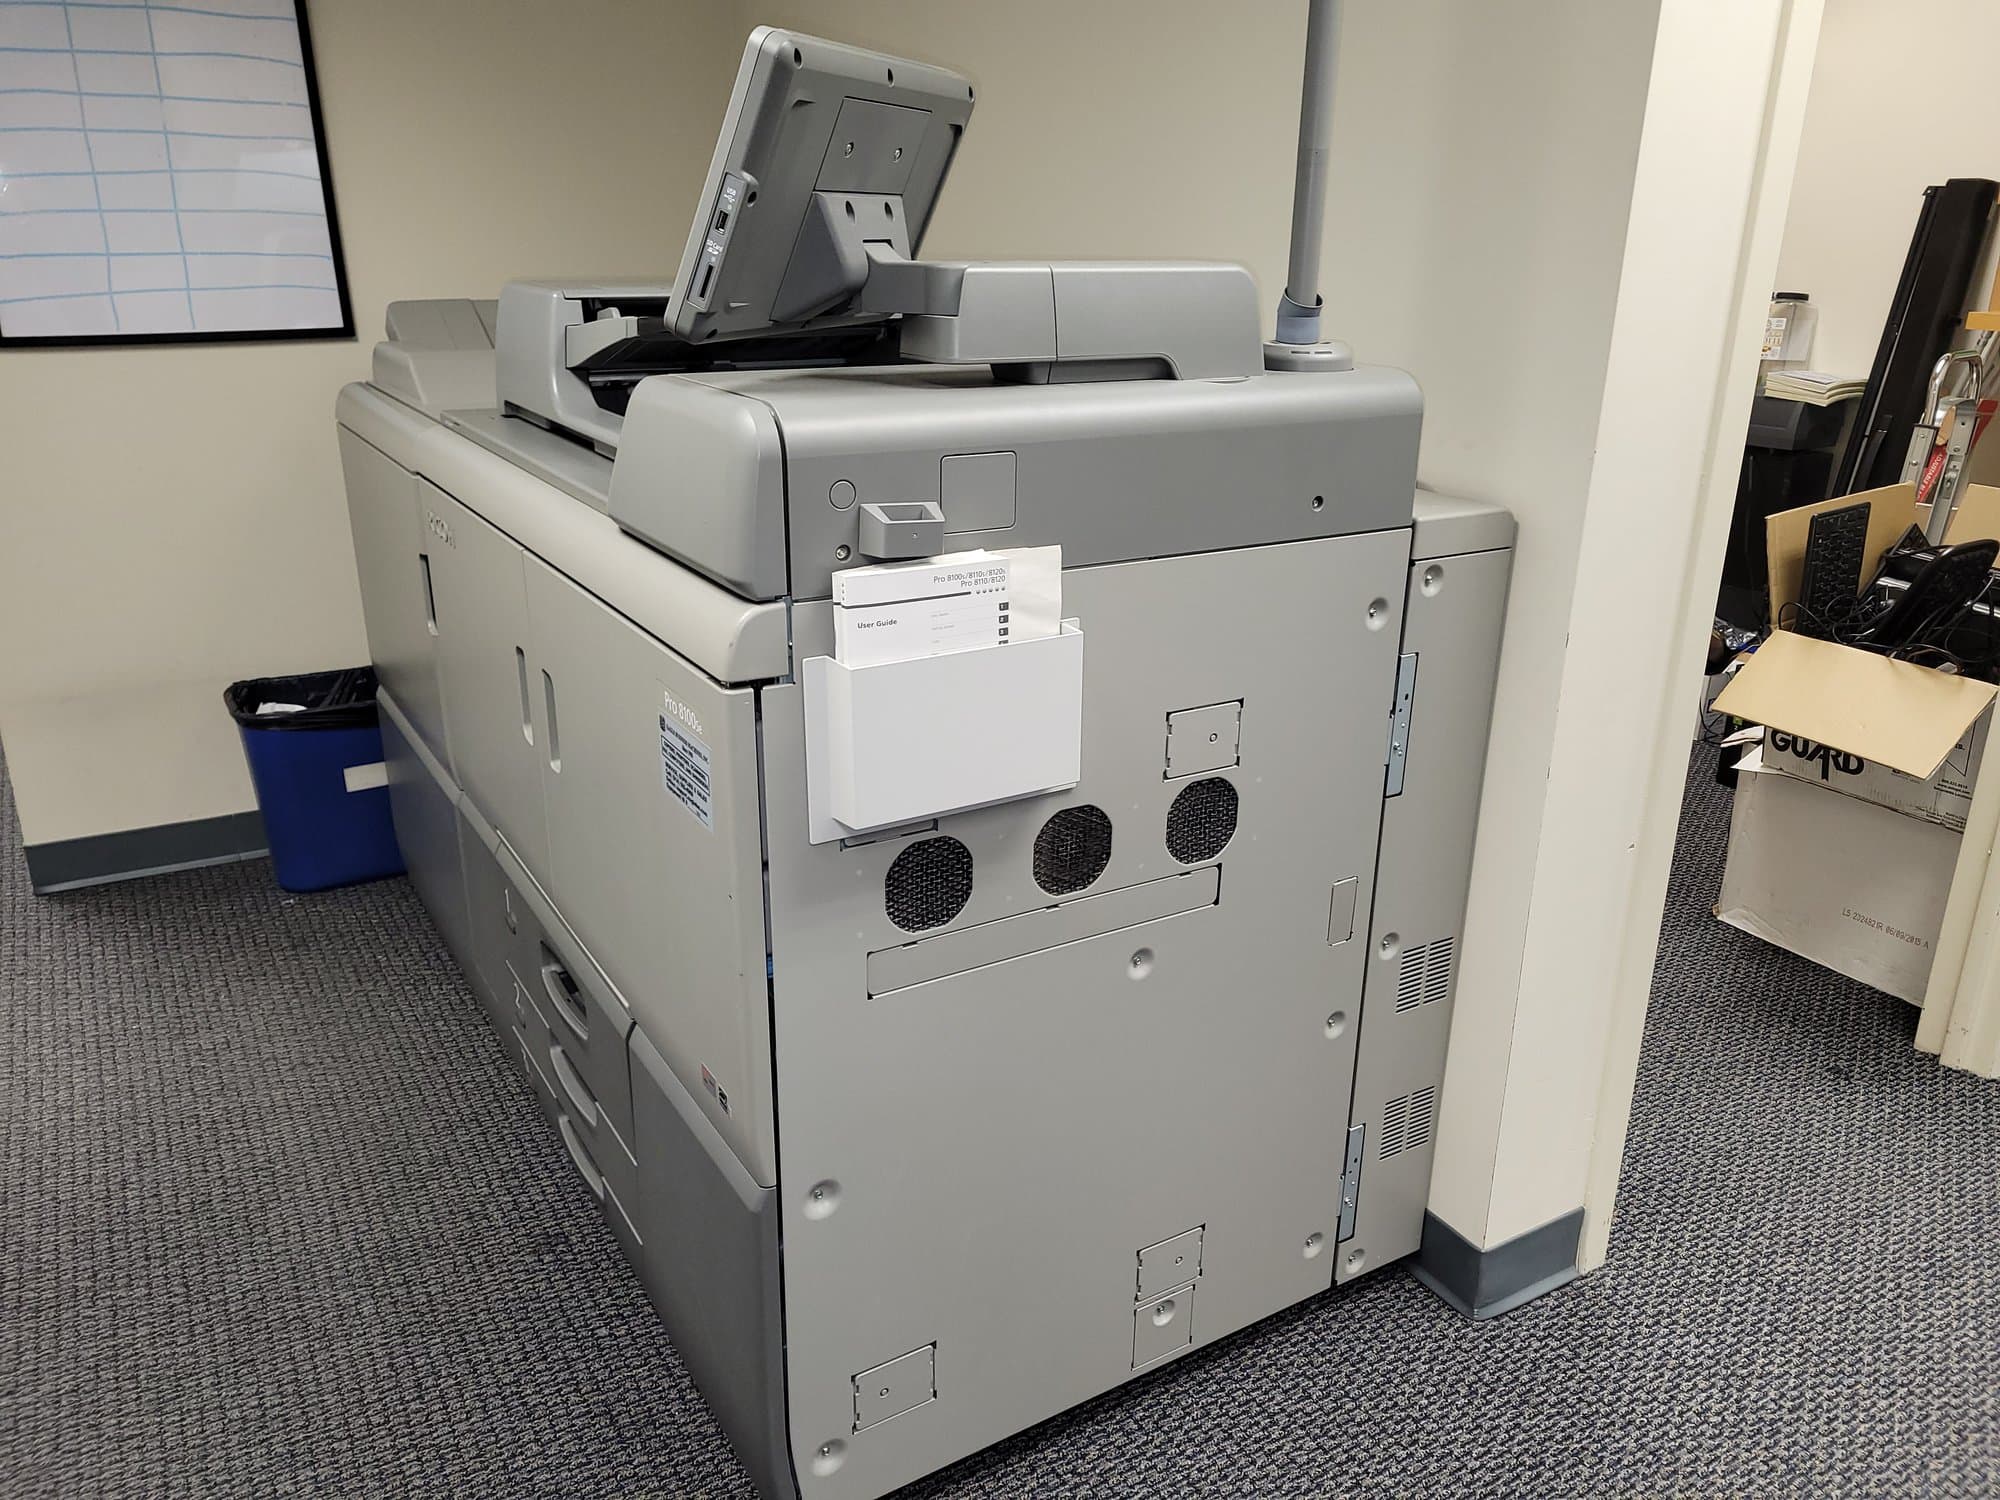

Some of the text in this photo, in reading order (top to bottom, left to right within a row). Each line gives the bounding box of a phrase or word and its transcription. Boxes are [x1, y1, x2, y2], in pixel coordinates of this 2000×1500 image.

[933, 575, 946, 584] Pro
[960, 575, 1006, 588] Pro 8110/8120
[876, 618, 898, 627] Guide
[664, 690, 678, 714] Pro
